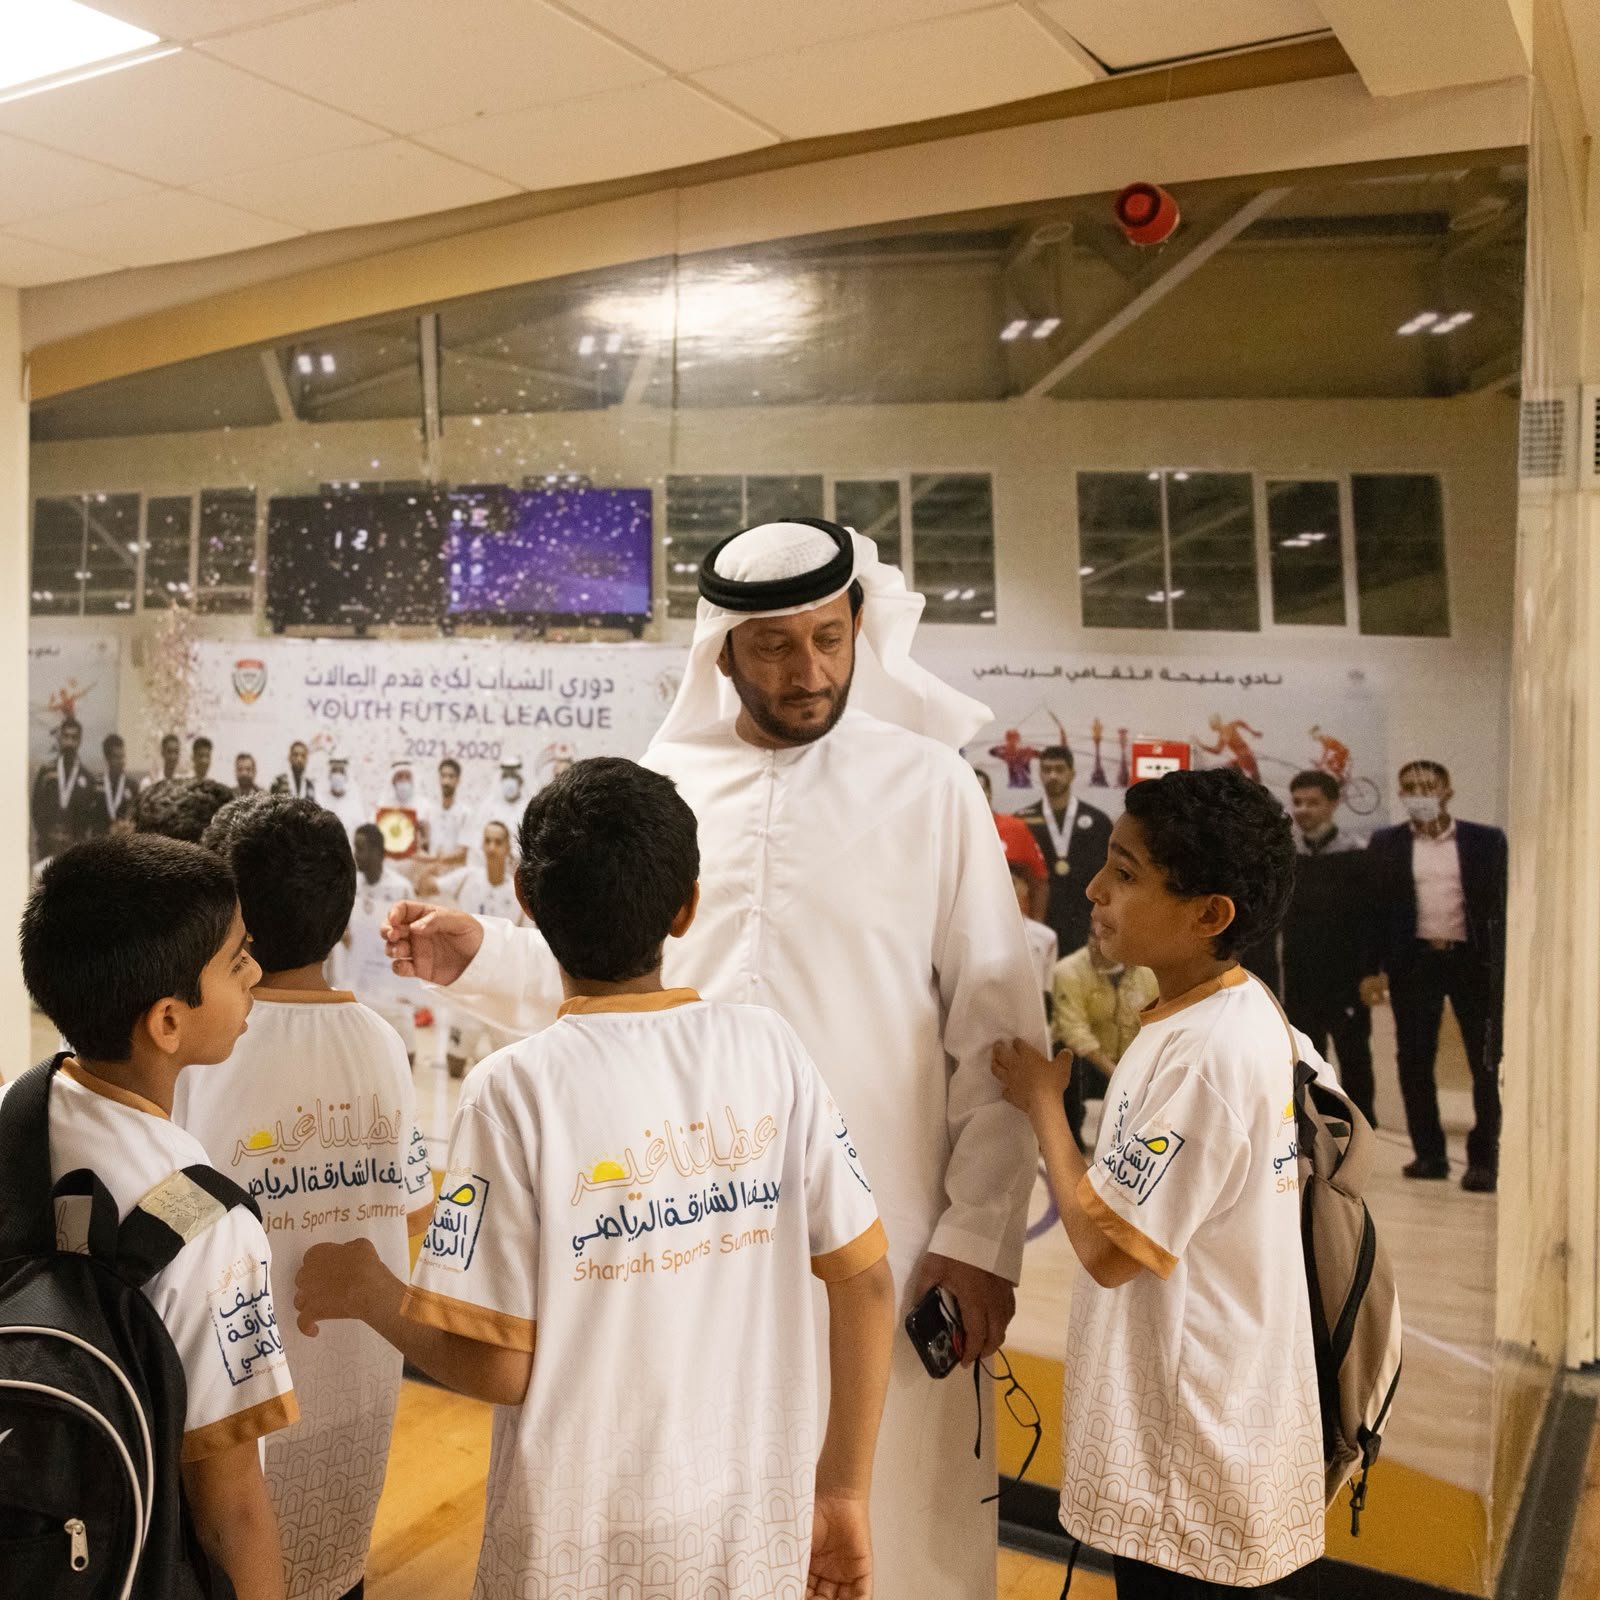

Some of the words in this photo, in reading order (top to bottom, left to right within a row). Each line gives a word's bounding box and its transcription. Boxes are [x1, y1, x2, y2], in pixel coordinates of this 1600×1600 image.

[304, 664, 377, 692] الصالات
[381, 667, 425, 698] قدم
[477, 666, 553, 694] الشباب
[972, 663, 1063, 680] الرياضي
[1065, 664, 1153, 684] الثقافي
[1158, 667, 1234, 686] مليحة
[1238, 672, 1284, 690] نادي
[559, 676, 615, 701] دوري
[306, 697, 393, 721] YOUTH
[399, 700, 495, 725] FUTSAL
[503, 703, 614, 730] LEAGUE
[308, 1157, 377, 1192] الشارقة
[301, 1206, 350, 1232] Sports
[356, 1203, 407, 1222] Summe
[664, 1180, 747, 1227] الشارقة
[571, 1200, 664, 1258] الرياضي
[573, 1252, 655, 1282] Sharjah
[660, 1239, 711, 1274] Sports
